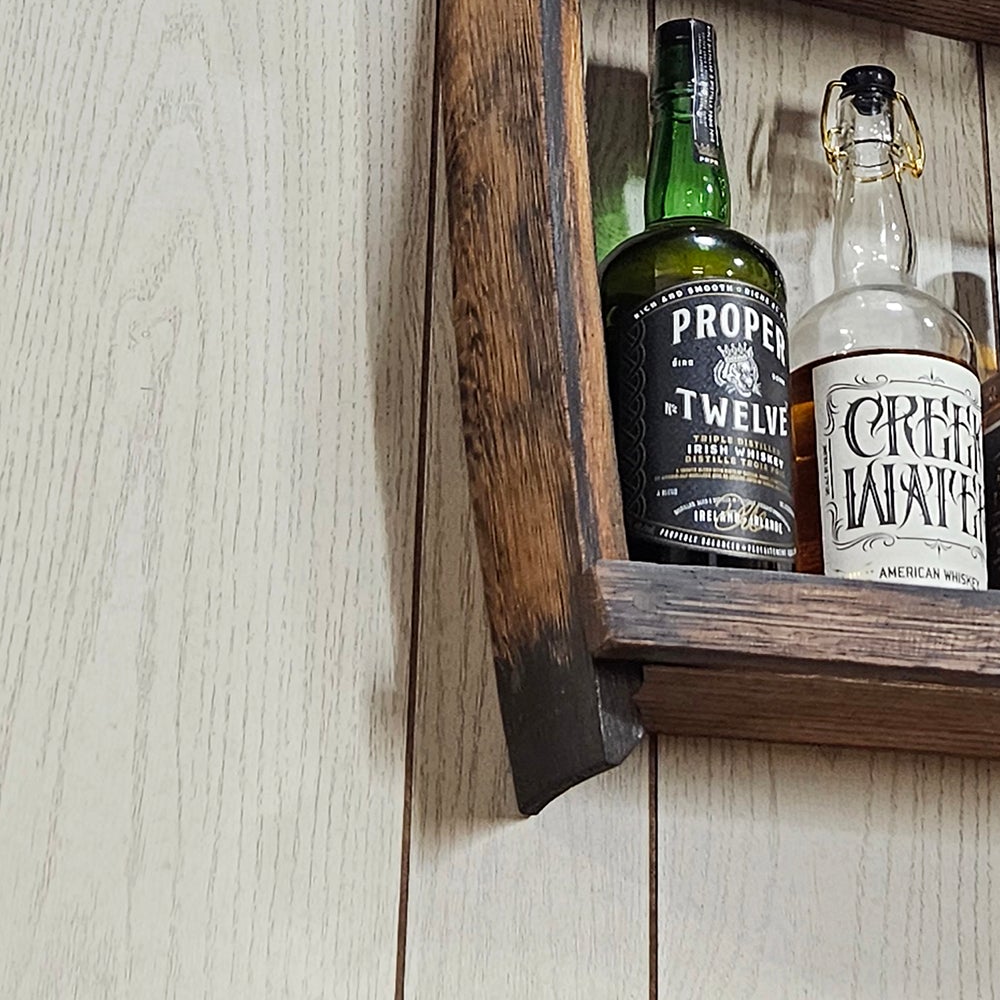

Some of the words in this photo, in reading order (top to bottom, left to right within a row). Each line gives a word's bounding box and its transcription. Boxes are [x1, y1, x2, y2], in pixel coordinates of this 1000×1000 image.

[633, 301, 658, 320] RICH
[661, 289, 684, 303] AND
[688, 283, 734, 296] SMOOTH
[670, 302, 786, 368] PROPER
[675, 387, 788, 437] TWELVE
[693, 434, 734, 445] TRIPLE
[687, 443, 729, 456] IRISH
[735, 446, 784, 470] WHISKEY
[659, 527, 698, 544] PROPERLY
[879, 566, 941, 579] AMERICAN
